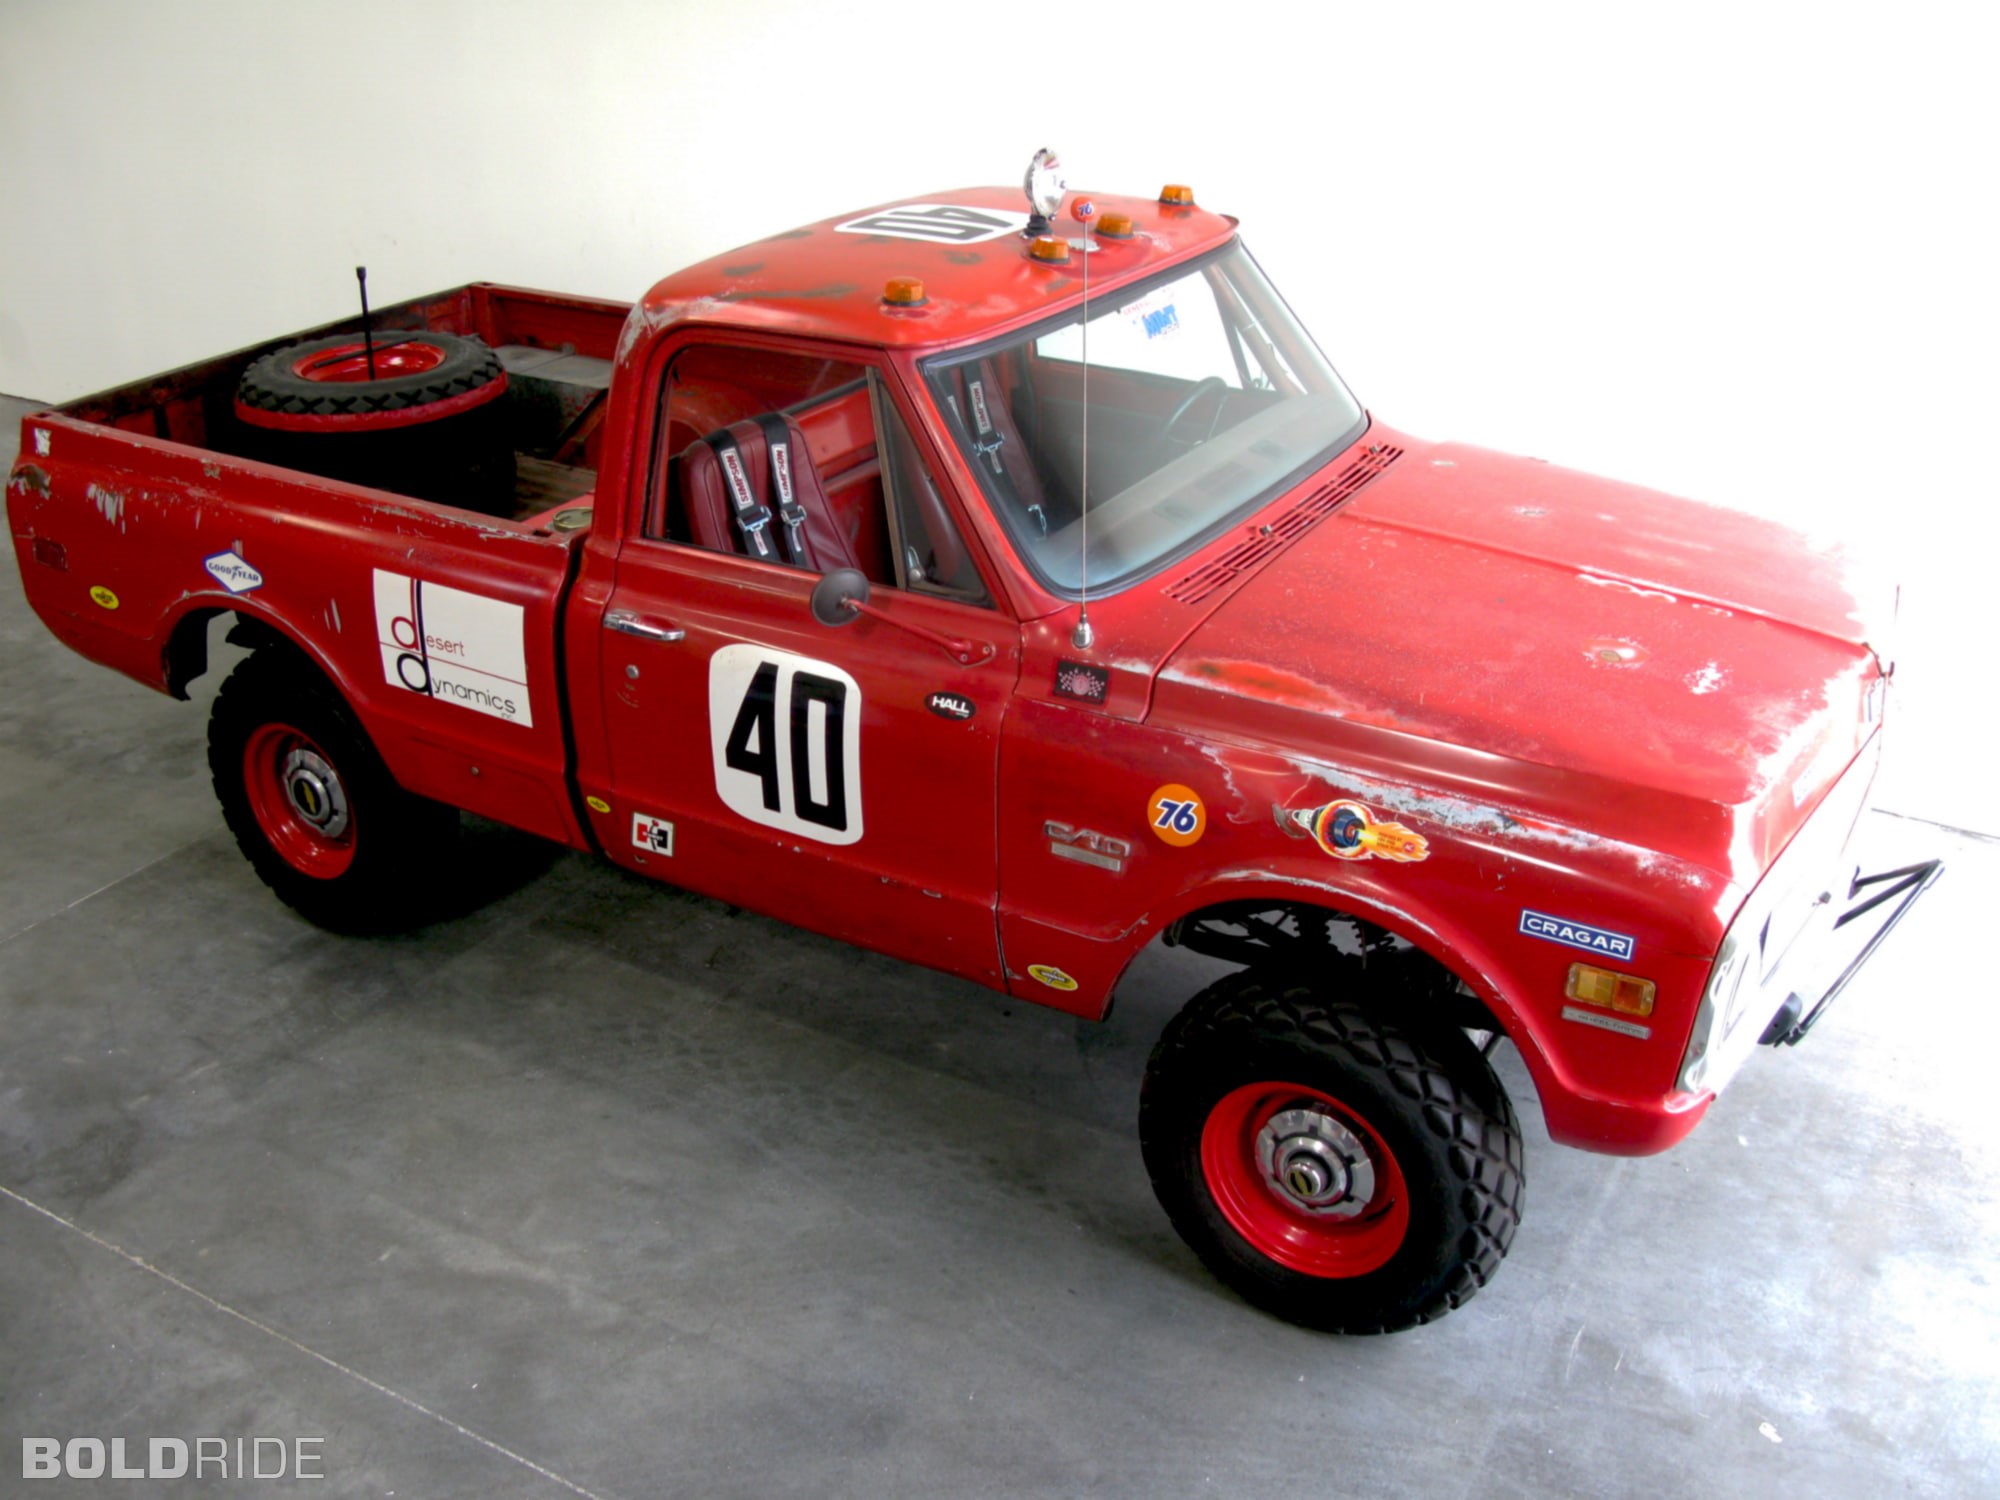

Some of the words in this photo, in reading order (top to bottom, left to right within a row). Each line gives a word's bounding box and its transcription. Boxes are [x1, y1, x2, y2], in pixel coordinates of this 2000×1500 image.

[1078, 203, 1093, 217] 76
[725, 455, 750, 502] SIMPSON
[776, 449, 790, 497] SIMPSON
[932, 695, 970, 713] HALL
[725, 661, 847, 832] 40
[1154, 798, 1197, 834] 76
[1526, 917, 1627, 954] CRAGAR
